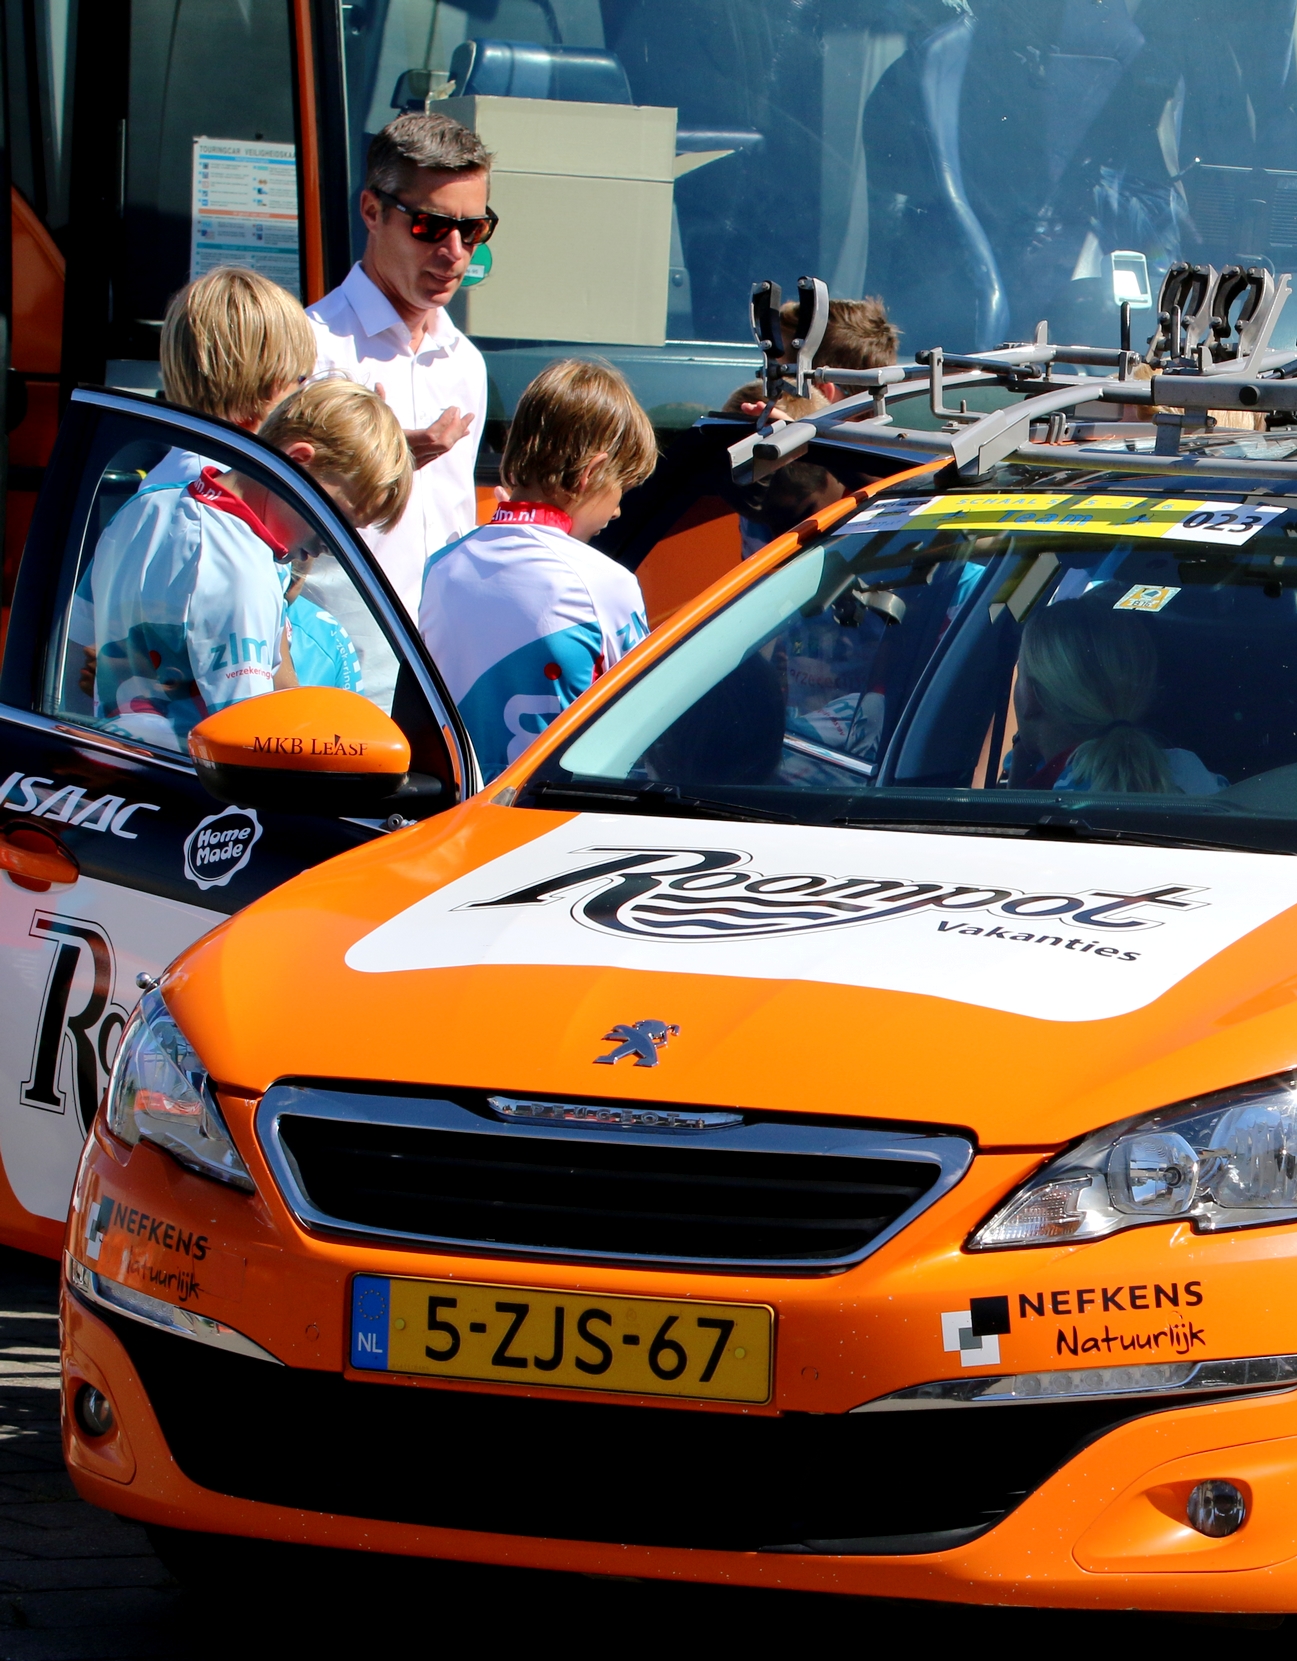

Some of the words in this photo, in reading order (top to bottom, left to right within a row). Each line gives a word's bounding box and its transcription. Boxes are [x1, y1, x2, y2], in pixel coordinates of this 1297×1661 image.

[199, 145, 241, 155] TOURINGCAR
[492, 507, 537, 522] lm.nl
[997, 509, 1094, 526] Team
[1182, 511, 1263, 533] 023
[210, 632, 271, 672] zlm
[225, 665, 274, 680] verzekering
[252, 736, 303, 755] MKB
[0, 771, 161, 840] ISAAC
[197, 827, 251, 848] Home
[196, 842, 243, 867] Made
[449, 845, 1212, 943] Roompot
[935, 919, 1143, 963] Vakanties
[113, 1202, 210, 1261] NEFKENS
[1018, 1281, 1204, 1318] NEFKENS
[357, 1332, 384, 1354] NL
[424, 1295, 736, 1383] 5-ZJS-67
[1056, 1321, 1206, 1356] Natuurlijk
